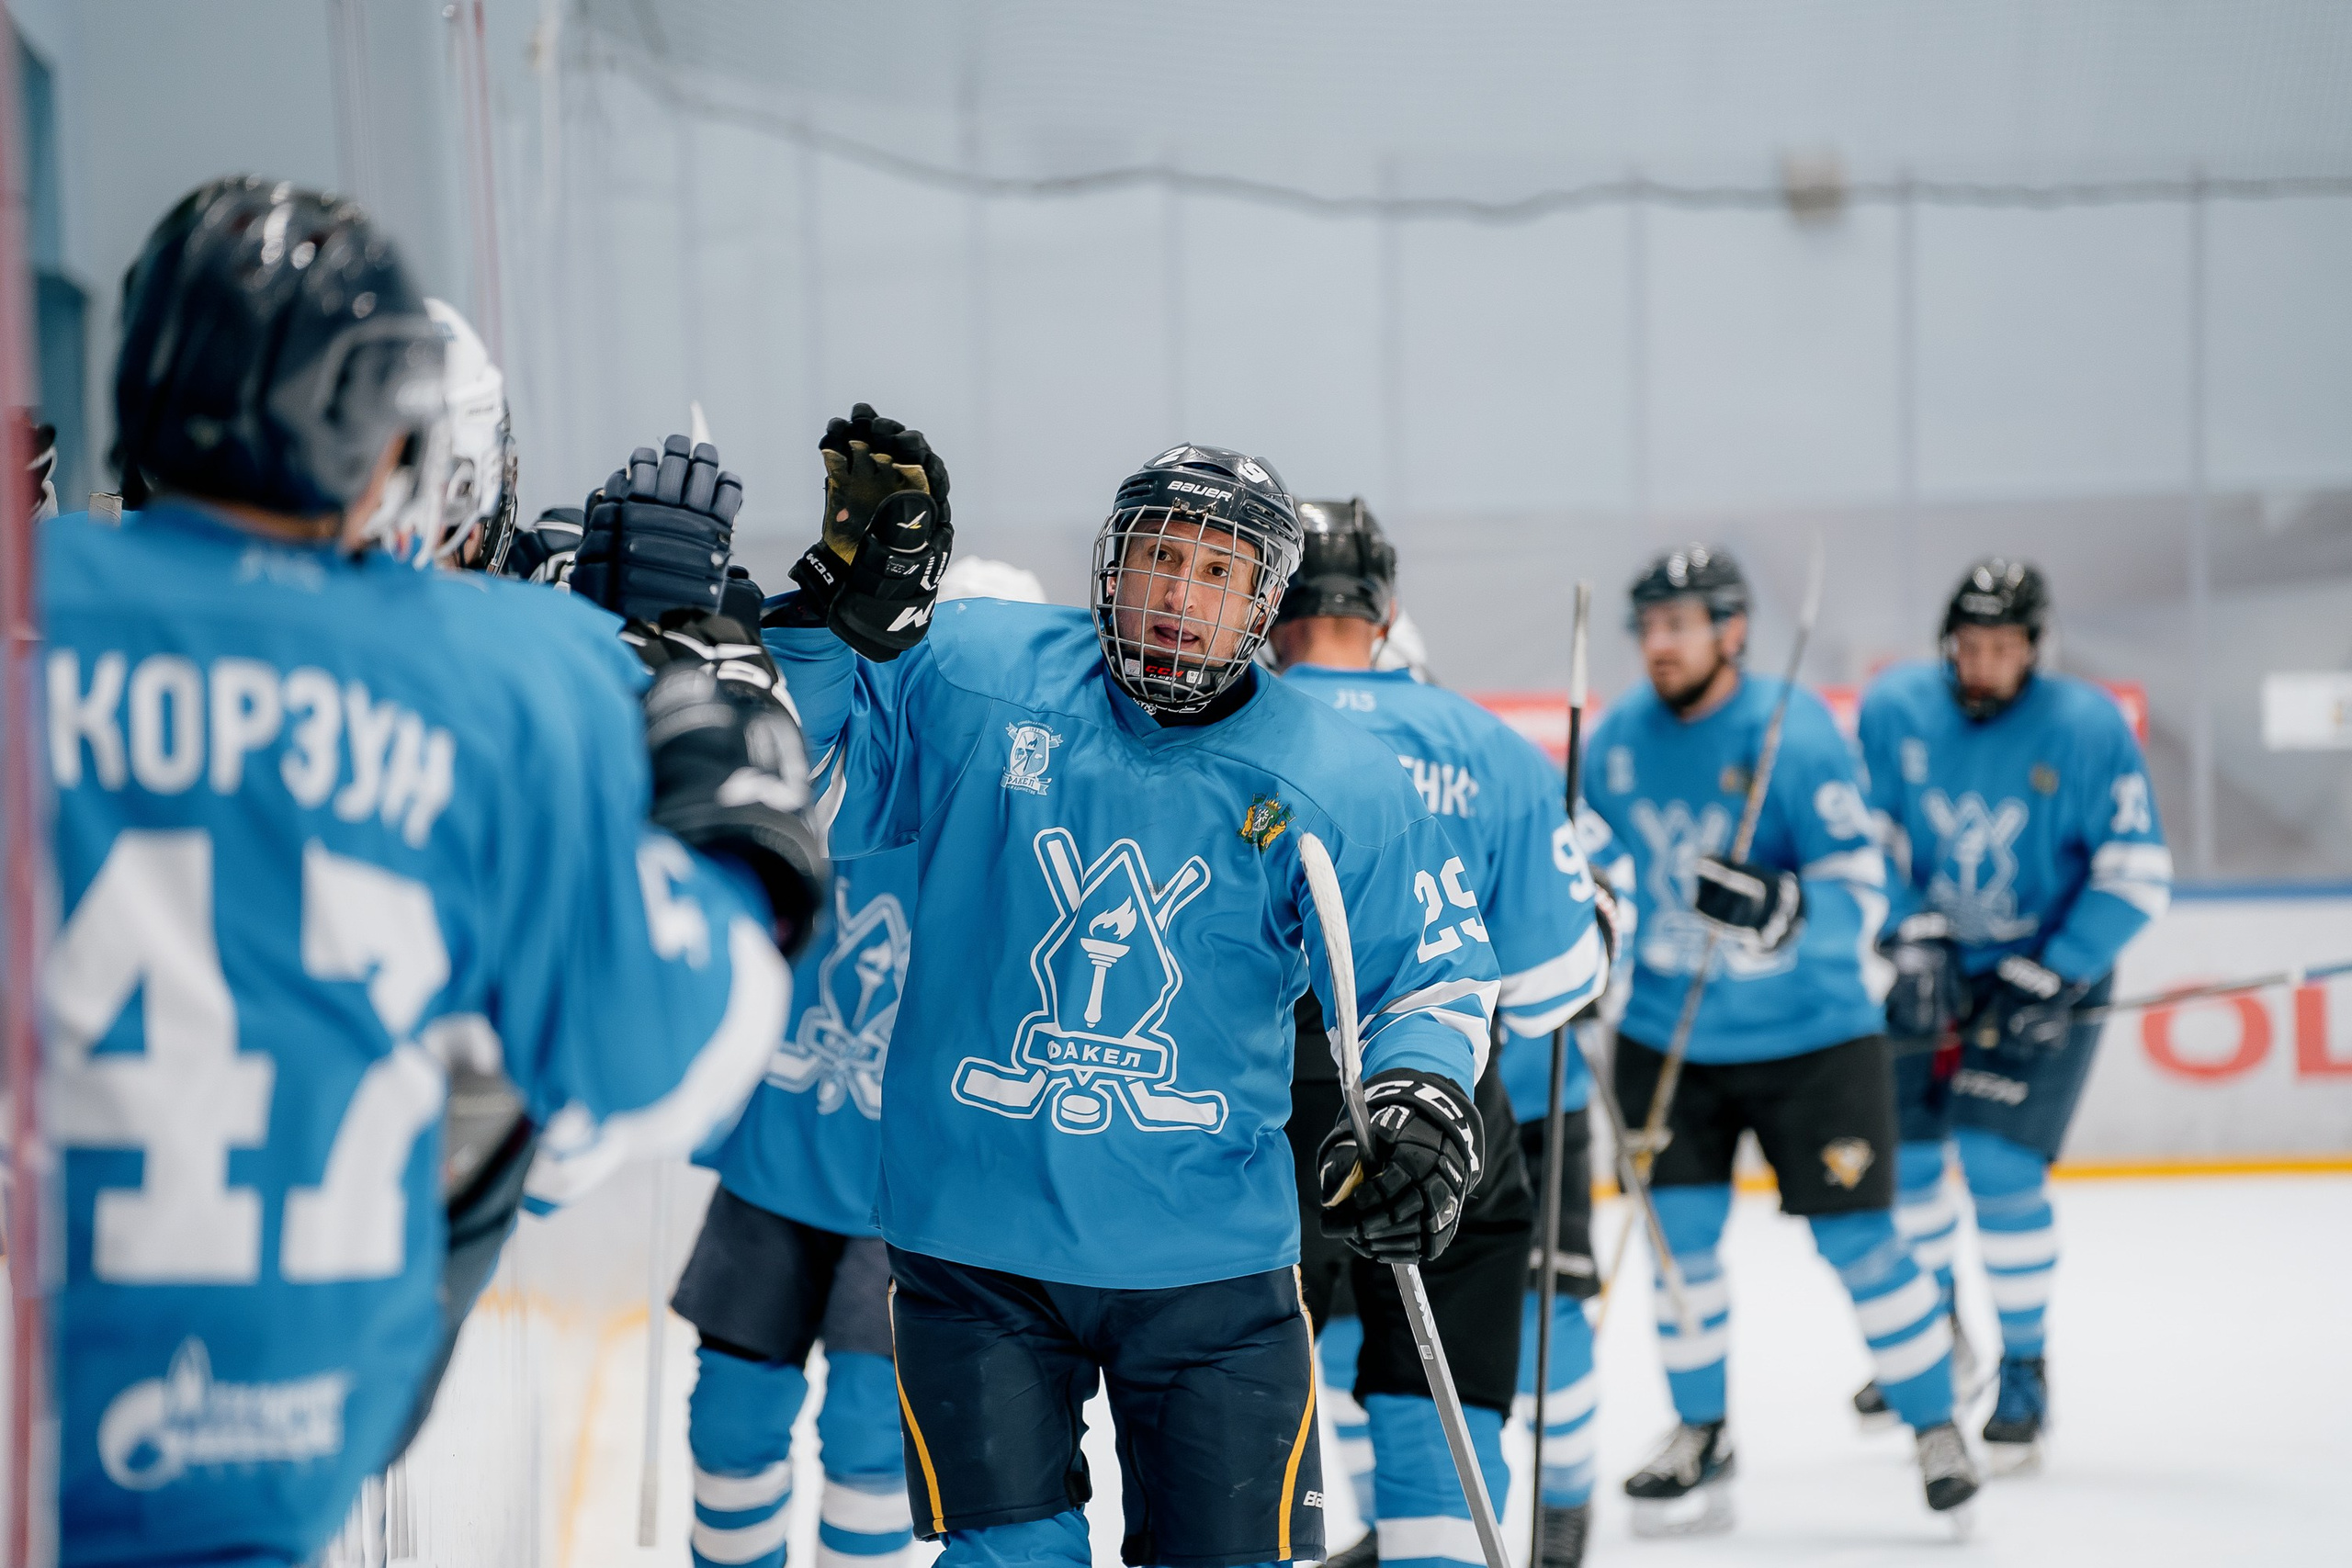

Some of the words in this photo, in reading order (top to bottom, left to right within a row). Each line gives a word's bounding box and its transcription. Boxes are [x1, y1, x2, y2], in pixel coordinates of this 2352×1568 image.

[1167, 479, 1233, 502] BAUER
[806, 552, 834, 585] CCM
[46, 647, 455, 851] КОРЗУН
[44, 825, 450, 1284] 47
[1046, 1040, 1142, 1068] ФАКЕЛ
[1363, 1080, 1480, 1172] CCM
